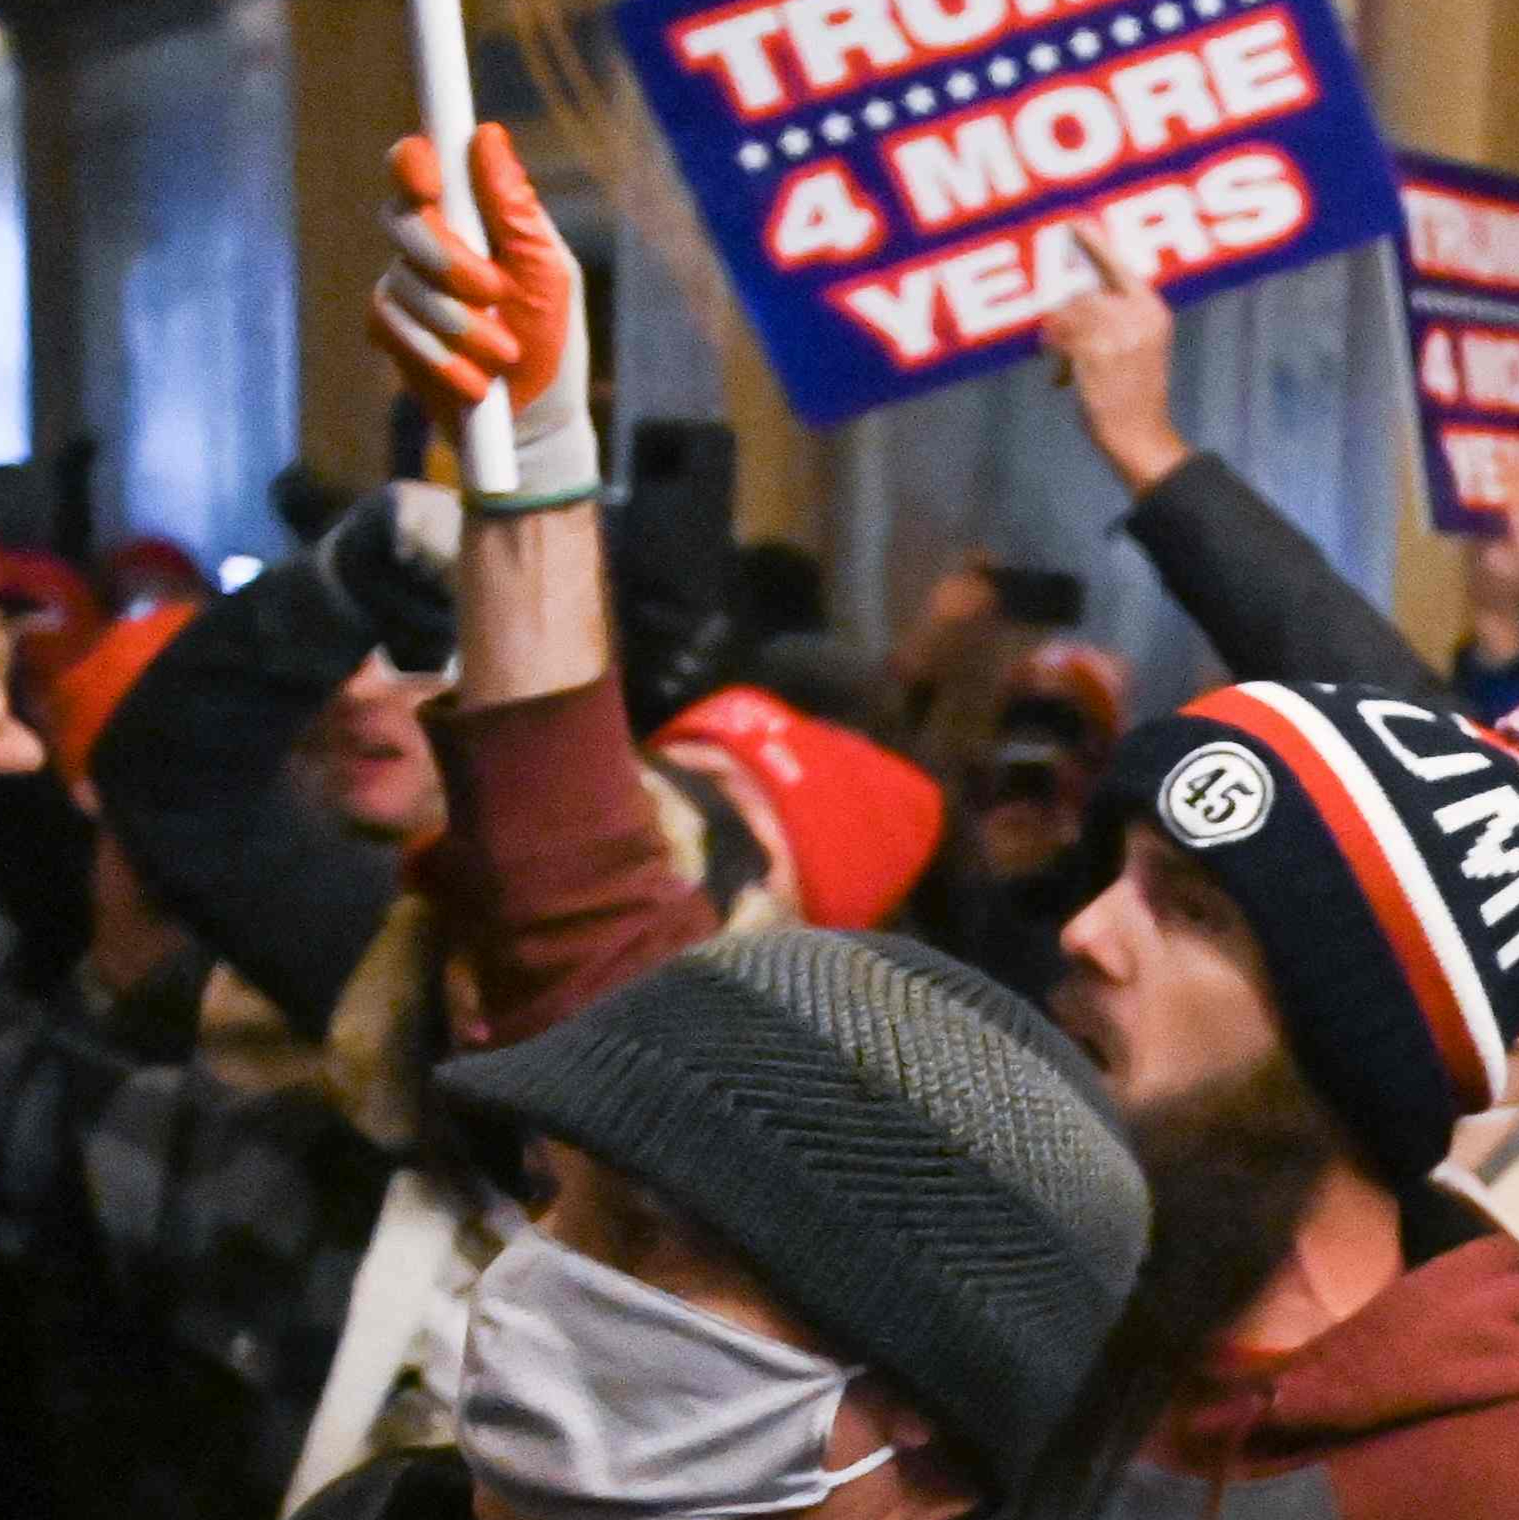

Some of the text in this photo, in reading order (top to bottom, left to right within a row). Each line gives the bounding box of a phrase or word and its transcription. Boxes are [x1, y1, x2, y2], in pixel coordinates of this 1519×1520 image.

[683, 0, 1072, 108] TRU
[773, 18, 1308, 264] 4 MORE
[1184, 767, 1255, 824] 45
